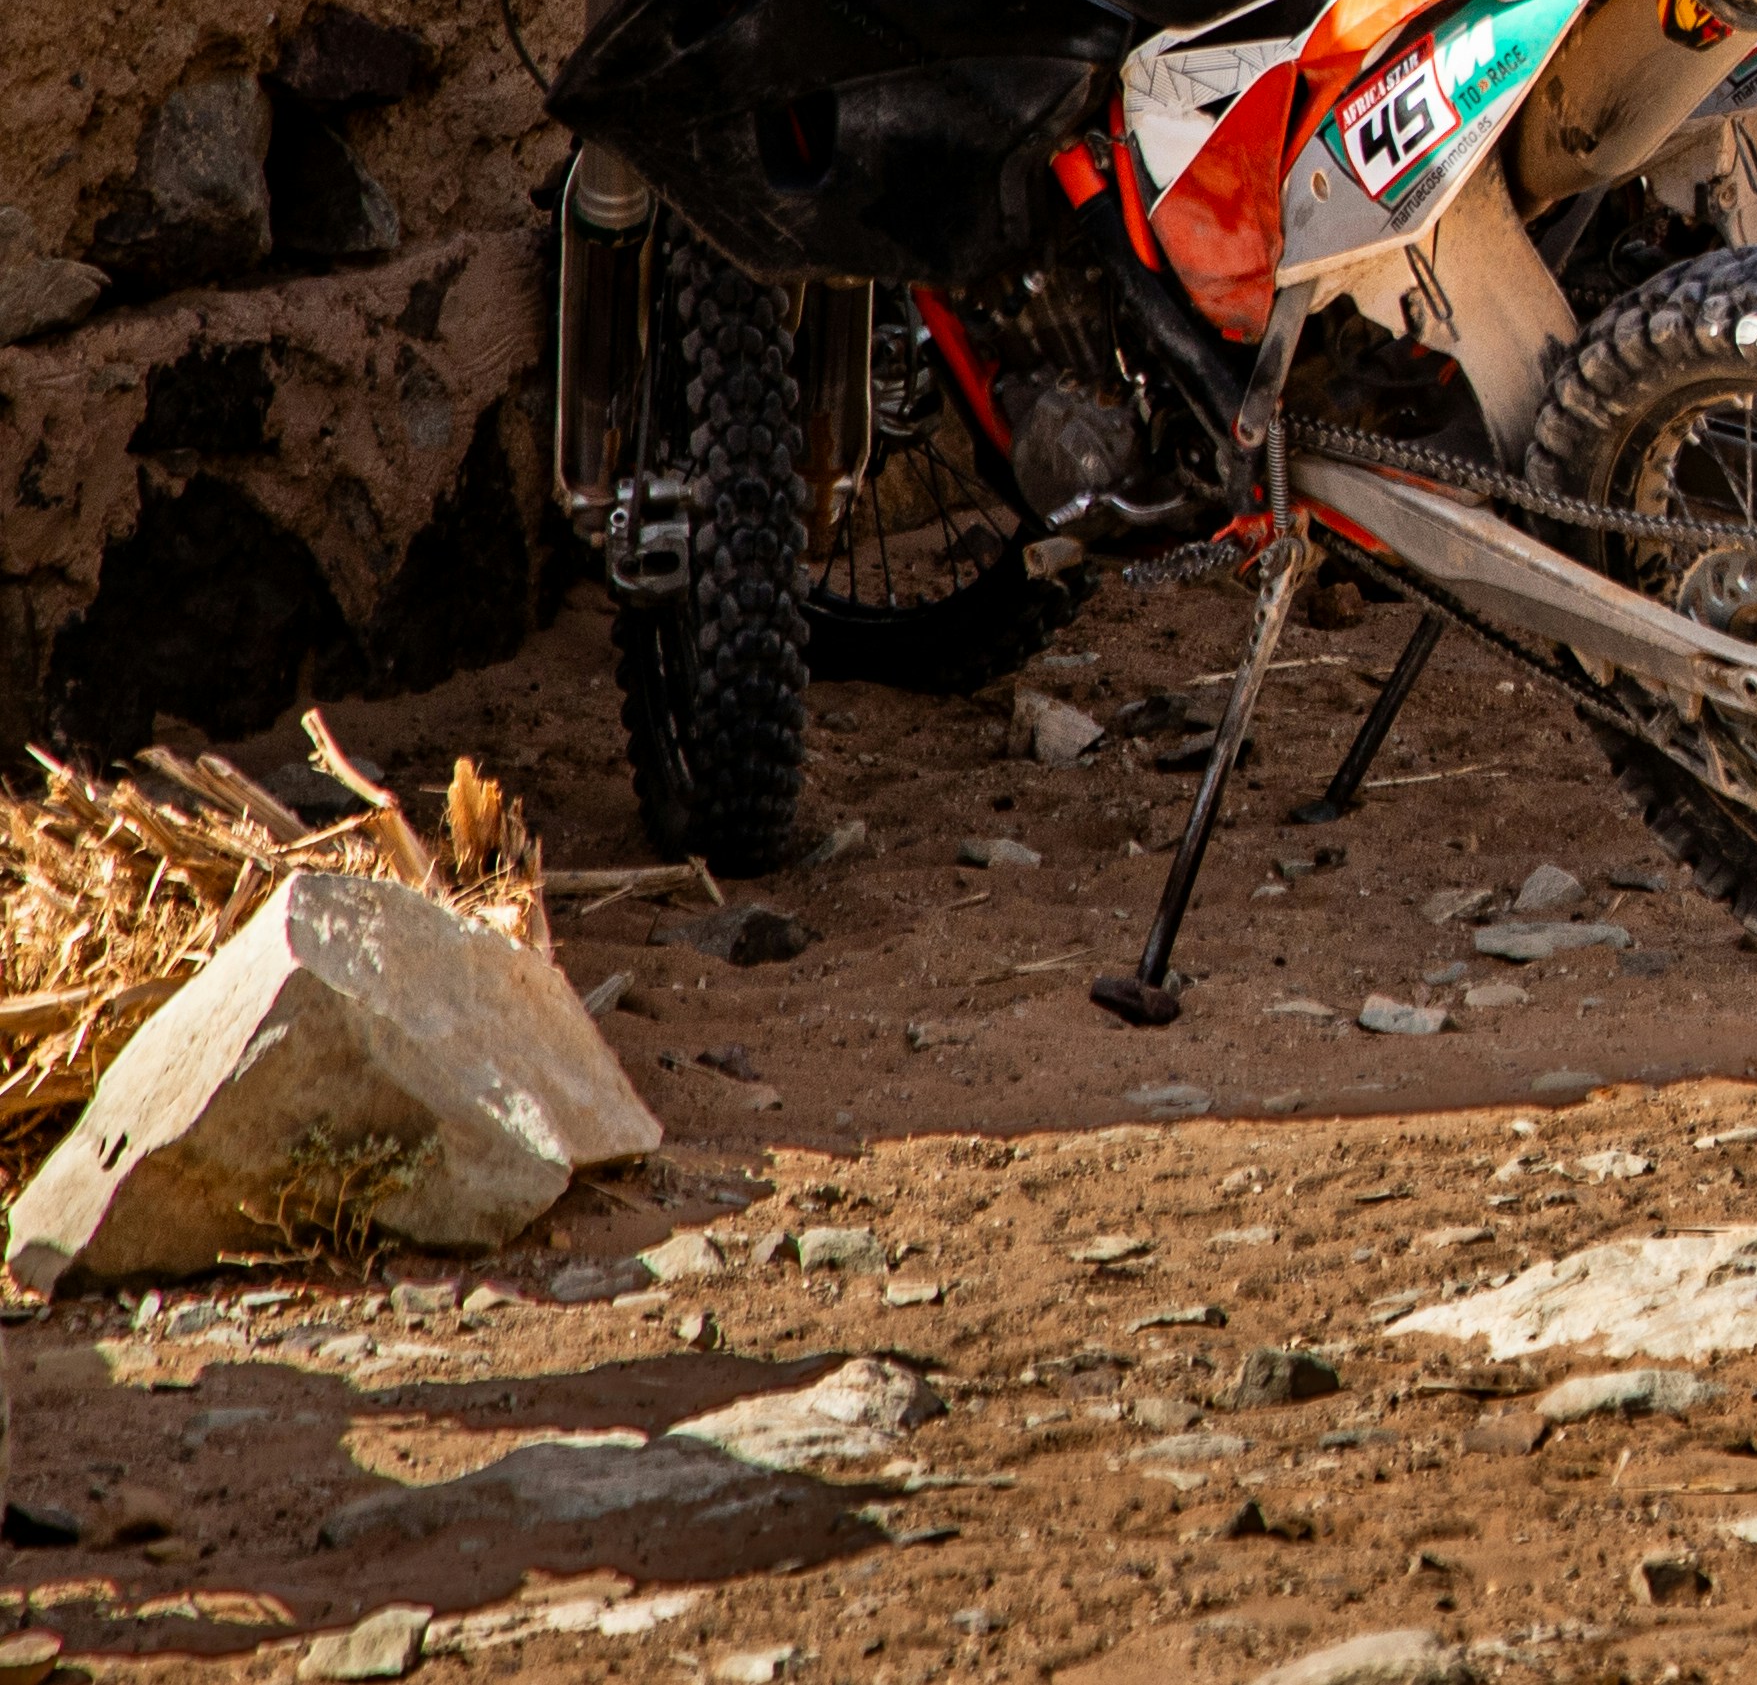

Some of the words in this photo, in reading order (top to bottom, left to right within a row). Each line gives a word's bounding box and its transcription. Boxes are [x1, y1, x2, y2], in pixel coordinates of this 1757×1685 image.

[1342, 83, 1388, 130] AFRICA
[1386, 51, 1420, 91] STAR
[1359, 73, 1436, 168] 45
[1458, 86, 1482, 112] TO
[1487, 44, 1528, 87] RACE
[1391, 116, 1494, 232] marruecosenmoto.es
